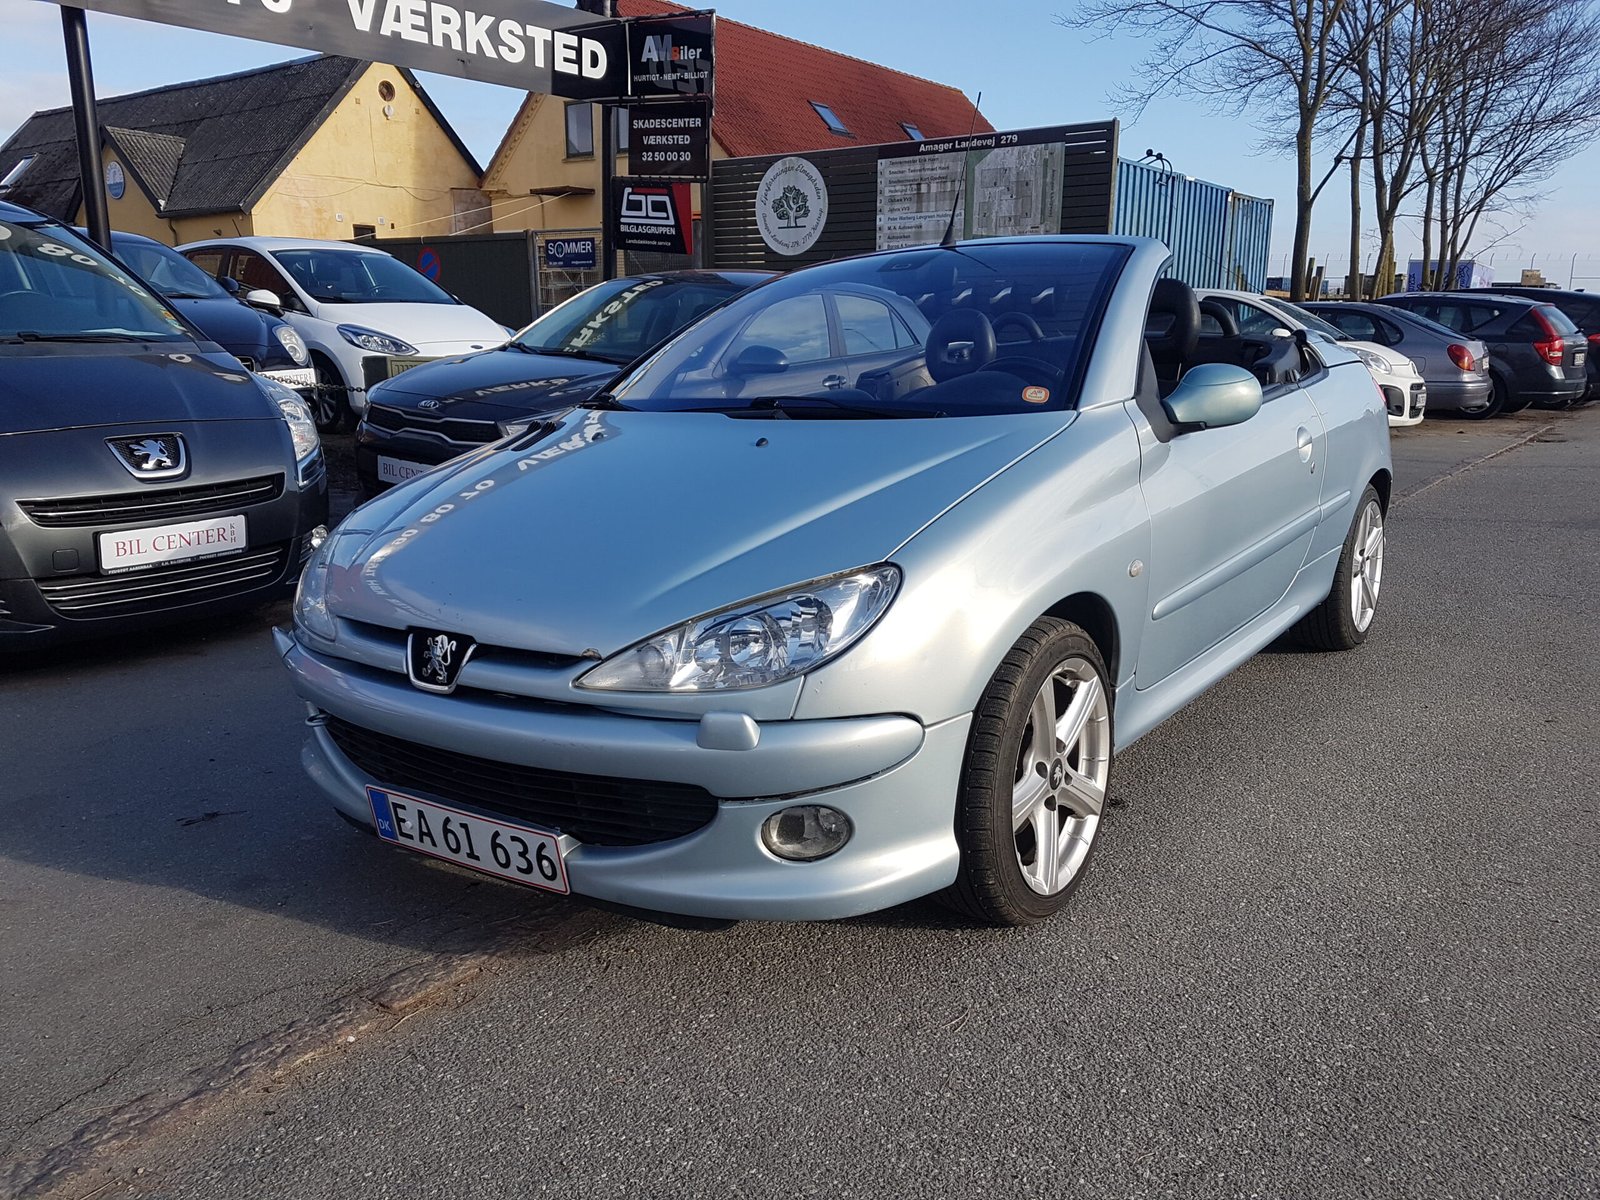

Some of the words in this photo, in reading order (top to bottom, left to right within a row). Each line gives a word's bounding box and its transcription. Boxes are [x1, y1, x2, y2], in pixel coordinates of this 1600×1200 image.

[346, 0, 608, 79] VÆRKSTED
[663, 72, 681, 80] NEMT
[684, 71, 709, 80] BILLIGT
[633, 117, 702, 129] SKADESCENTER
[643, 135, 691, 145] VÆRKSTED
[919, 142, 953, 153] Amager
[955, 137, 996, 148] Landevej
[1000, 134, 1018, 144] 279
[641, 151, 653, 162] 32
[654, 151, 666, 161] 50
[666, 151, 678, 161] 00
[679, 151, 691, 161] 30
[620, 224, 676, 235] BILGLASGRUPPEN
[547, 241, 592, 258] SOMMER
[383, 462, 397, 477] BIL
[115, 539, 148, 557] BIL
[152, 527, 228, 552] CENTER
[378, 819, 392, 831] DK
[490, 829, 558, 882] 636
